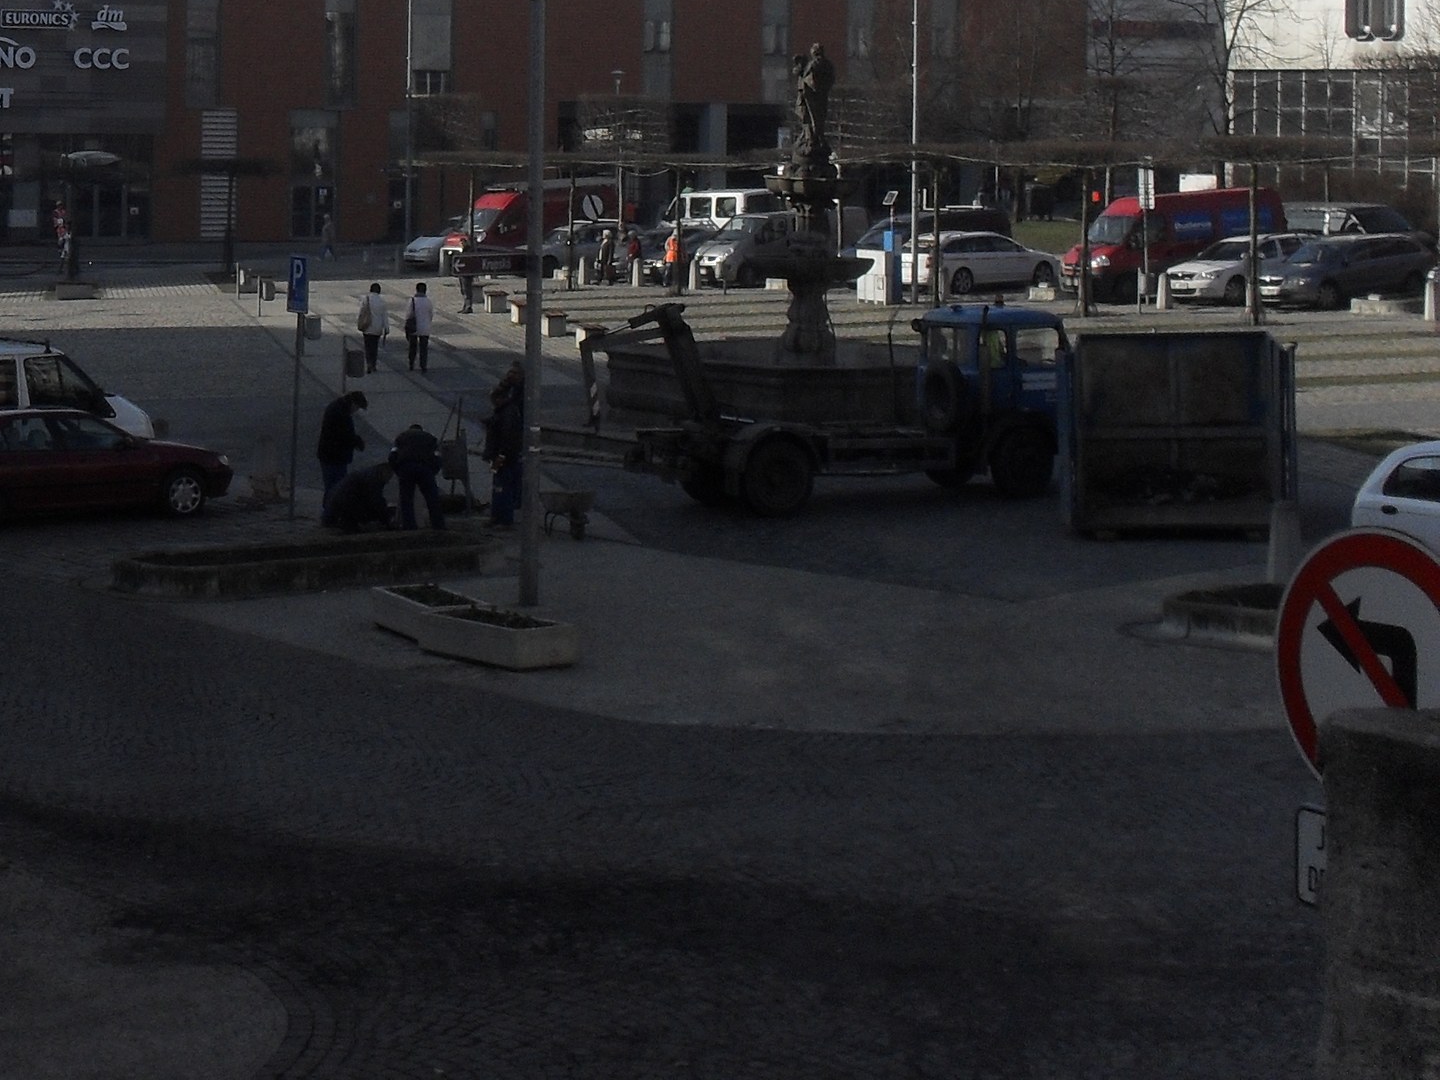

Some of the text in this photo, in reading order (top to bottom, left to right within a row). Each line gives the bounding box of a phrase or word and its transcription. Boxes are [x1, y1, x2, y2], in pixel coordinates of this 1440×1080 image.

[5, 11, 70, 26] EURONICS
[96, 5, 124, 22] dm
[73, 47, 130, 70] CCC
[293, 259, 303, 289] P
